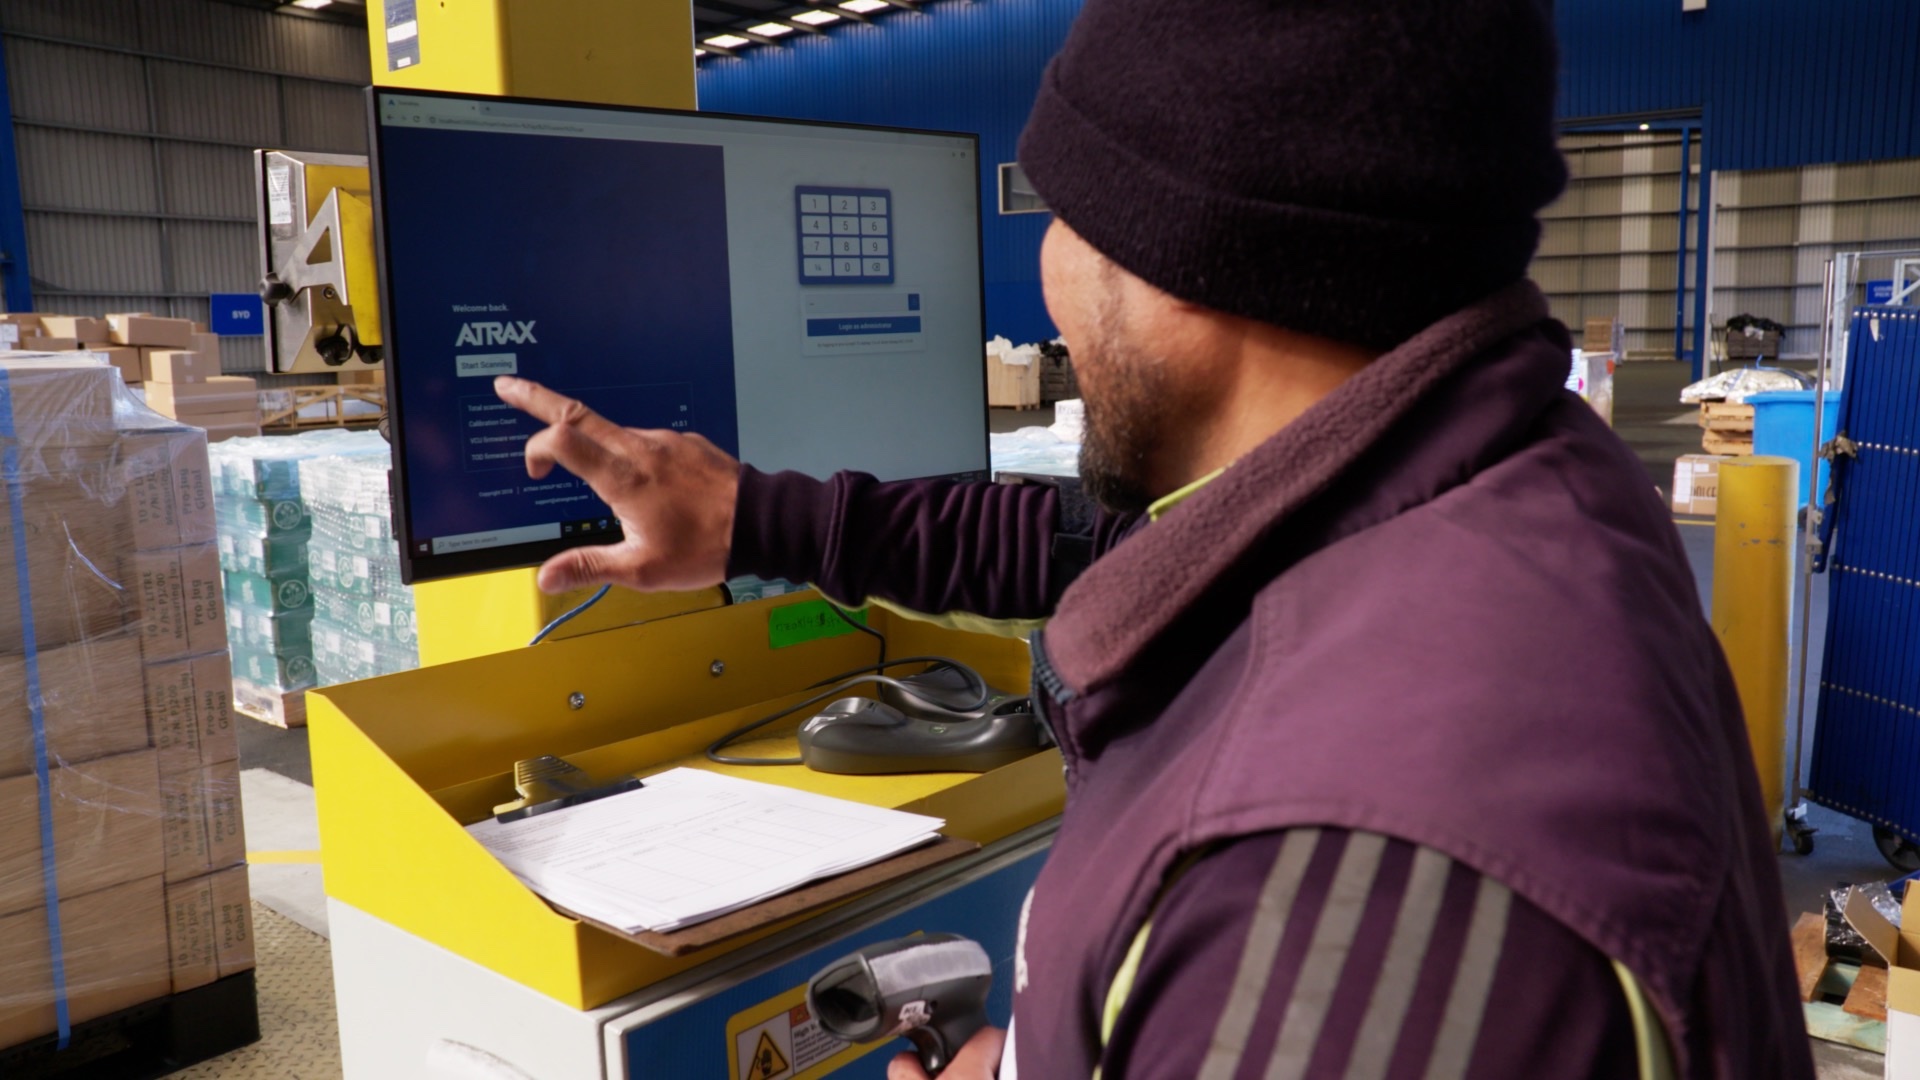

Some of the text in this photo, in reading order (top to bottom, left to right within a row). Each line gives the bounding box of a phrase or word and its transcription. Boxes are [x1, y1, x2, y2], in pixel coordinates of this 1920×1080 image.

[842, 200, 848, 210] 2
[870, 201, 876, 211] 3
[813, 220, 877, 231] 4 5 6
[814, 241, 878, 251] 7 8 9
[452, 303, 509, 312] Welcome back.
[232, 310, 251, 319] SYD
[838, 322, 853, 331] Login
[455, 320, 538, 347] ATRAX
[461, 359, 513, 370] Start Scanning
[468, 418, 517, 428] Calibration Count
[191, 469, 206, 510] Global
[143, 569, 154, 602] LITRE
[203, 581, 217, 620] Global
[171, 584, 183, 639] Measuring
[215, 690, 228, 729] Global
[233, 903, 246, 942] Global
[793, 1026, 810, 1038] High
